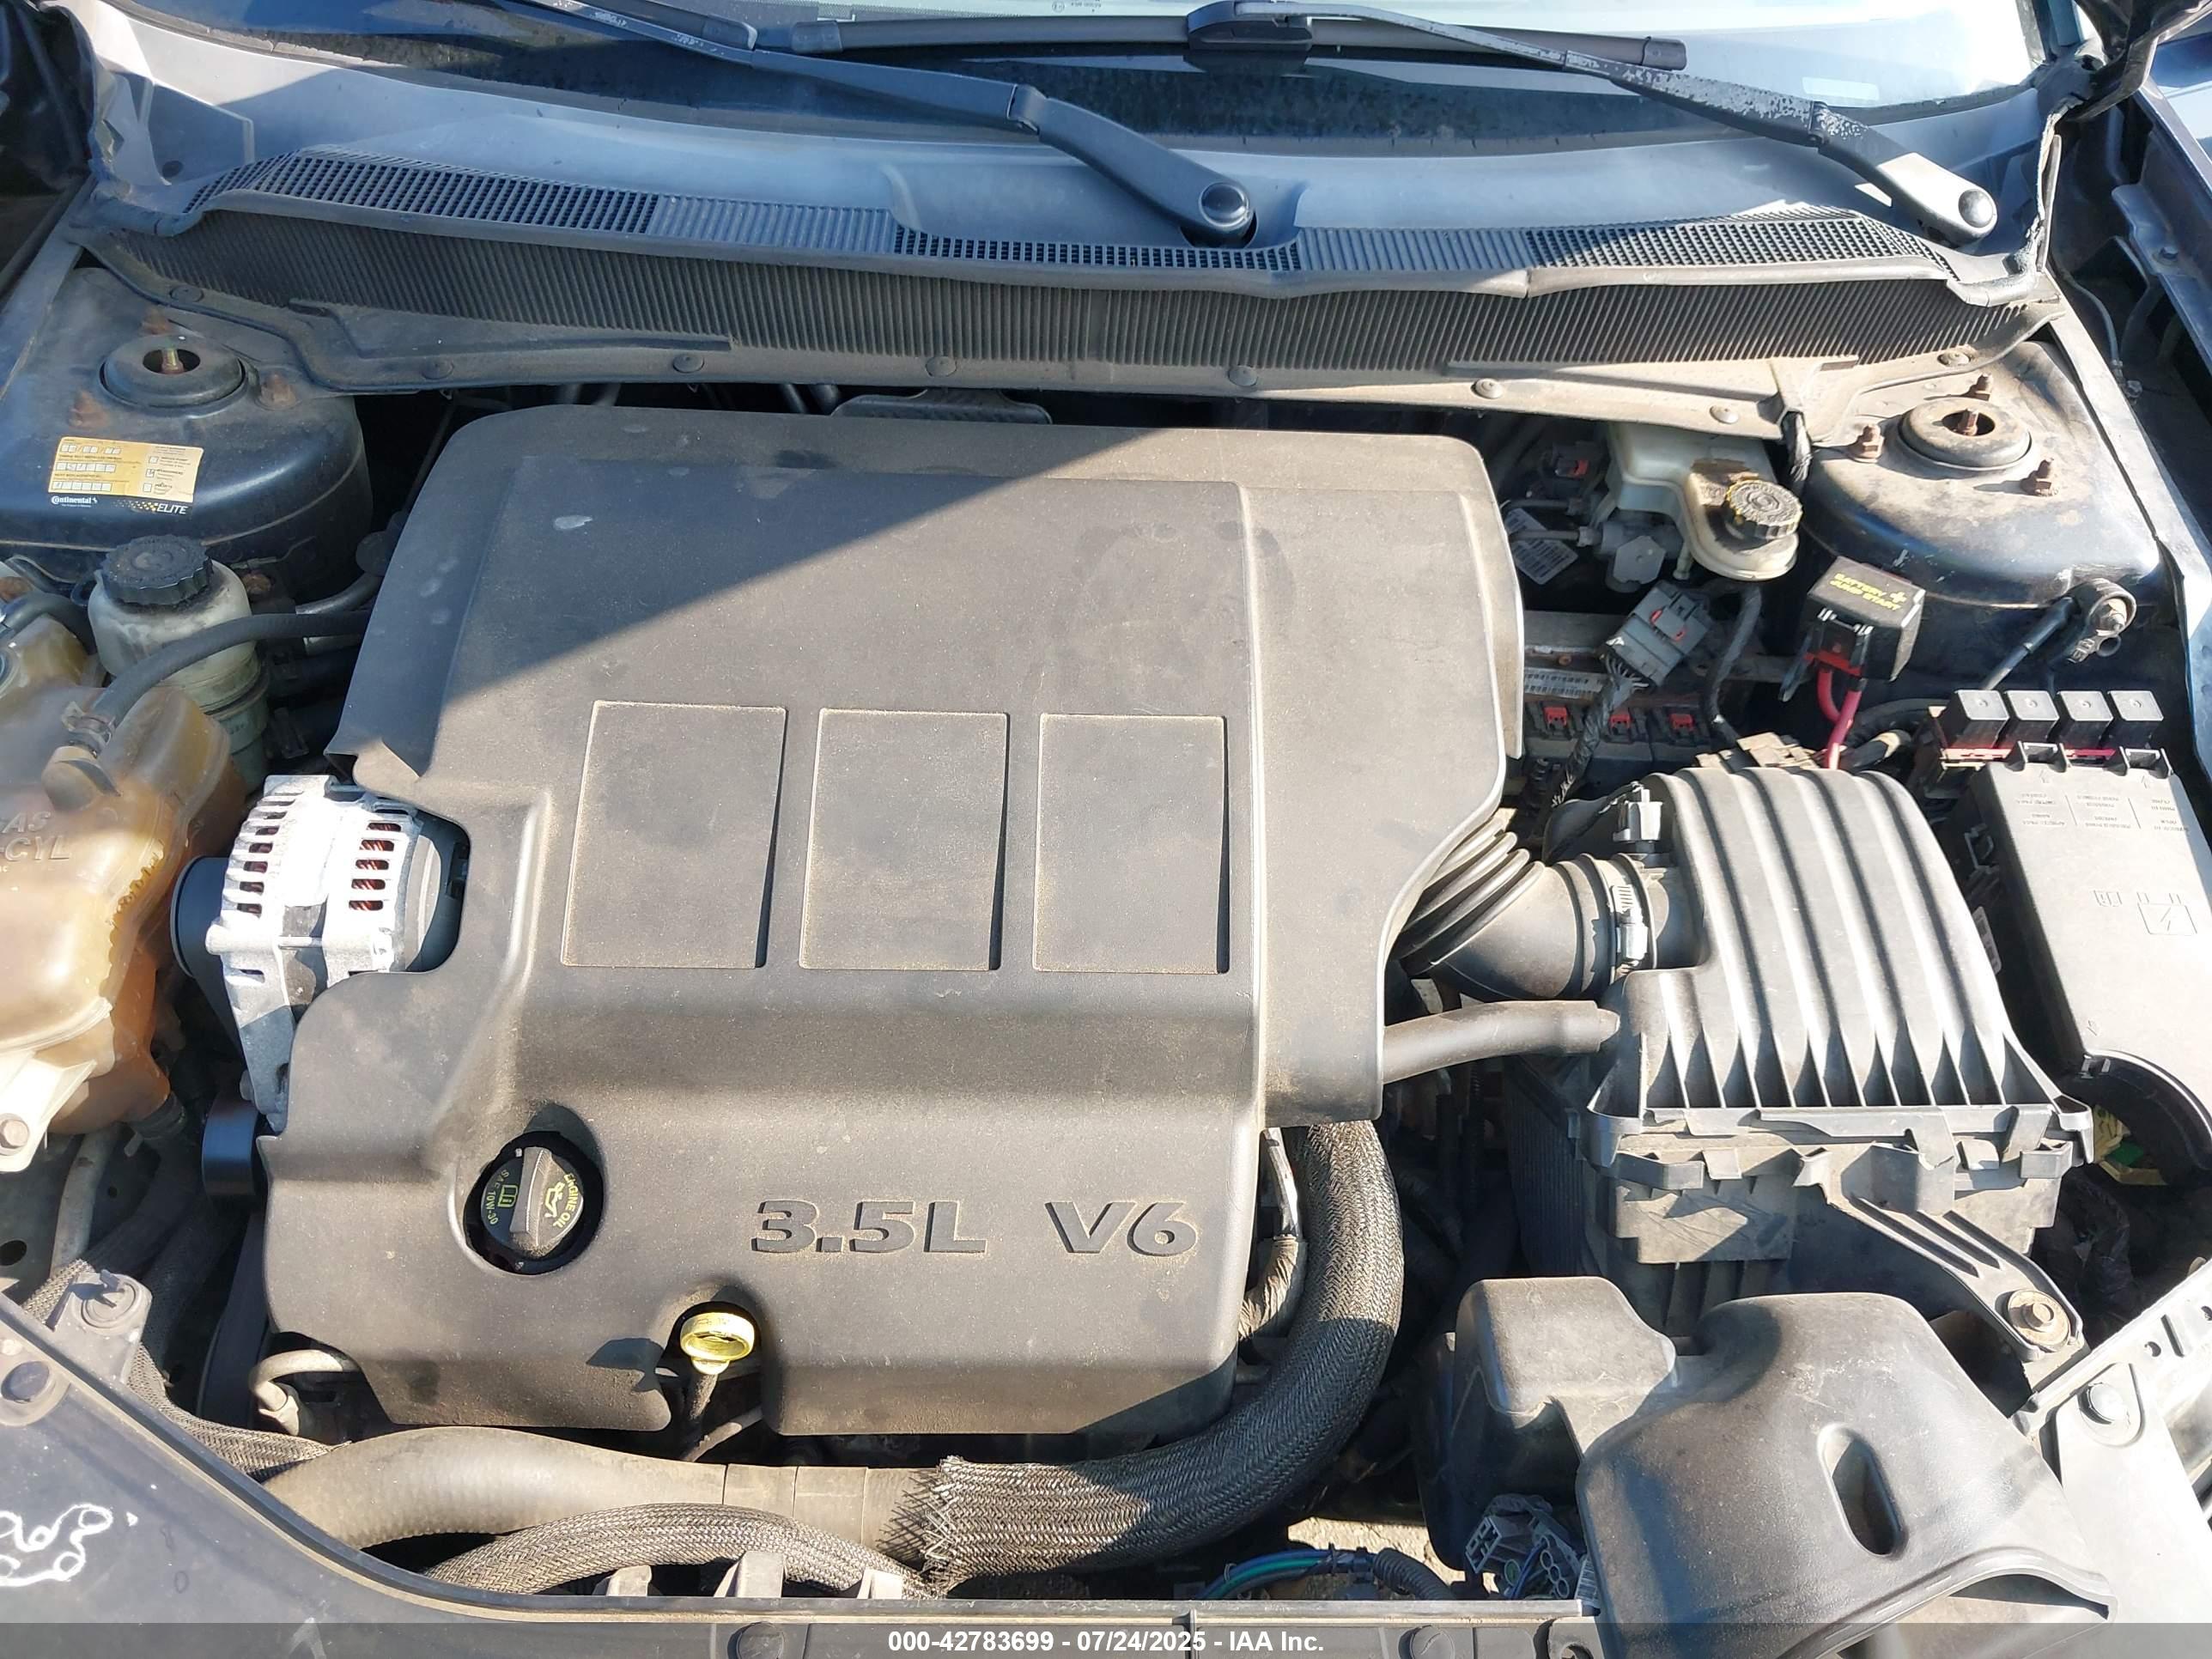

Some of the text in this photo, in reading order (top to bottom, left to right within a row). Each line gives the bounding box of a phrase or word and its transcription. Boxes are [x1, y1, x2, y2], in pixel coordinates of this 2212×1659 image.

[52, 495, 92, 505] Continental
[157, 503, 188, 514] ELITE
[1834, 573, 1887, 598] BATTERY
[1863, 592, 1902, 611] START
[486, 1190, 499, 1225] 10W-30
[552, 1173, 579, 1228] ENGINE OIL
[750, 1200, 1198, 1257] 3.5L V6
